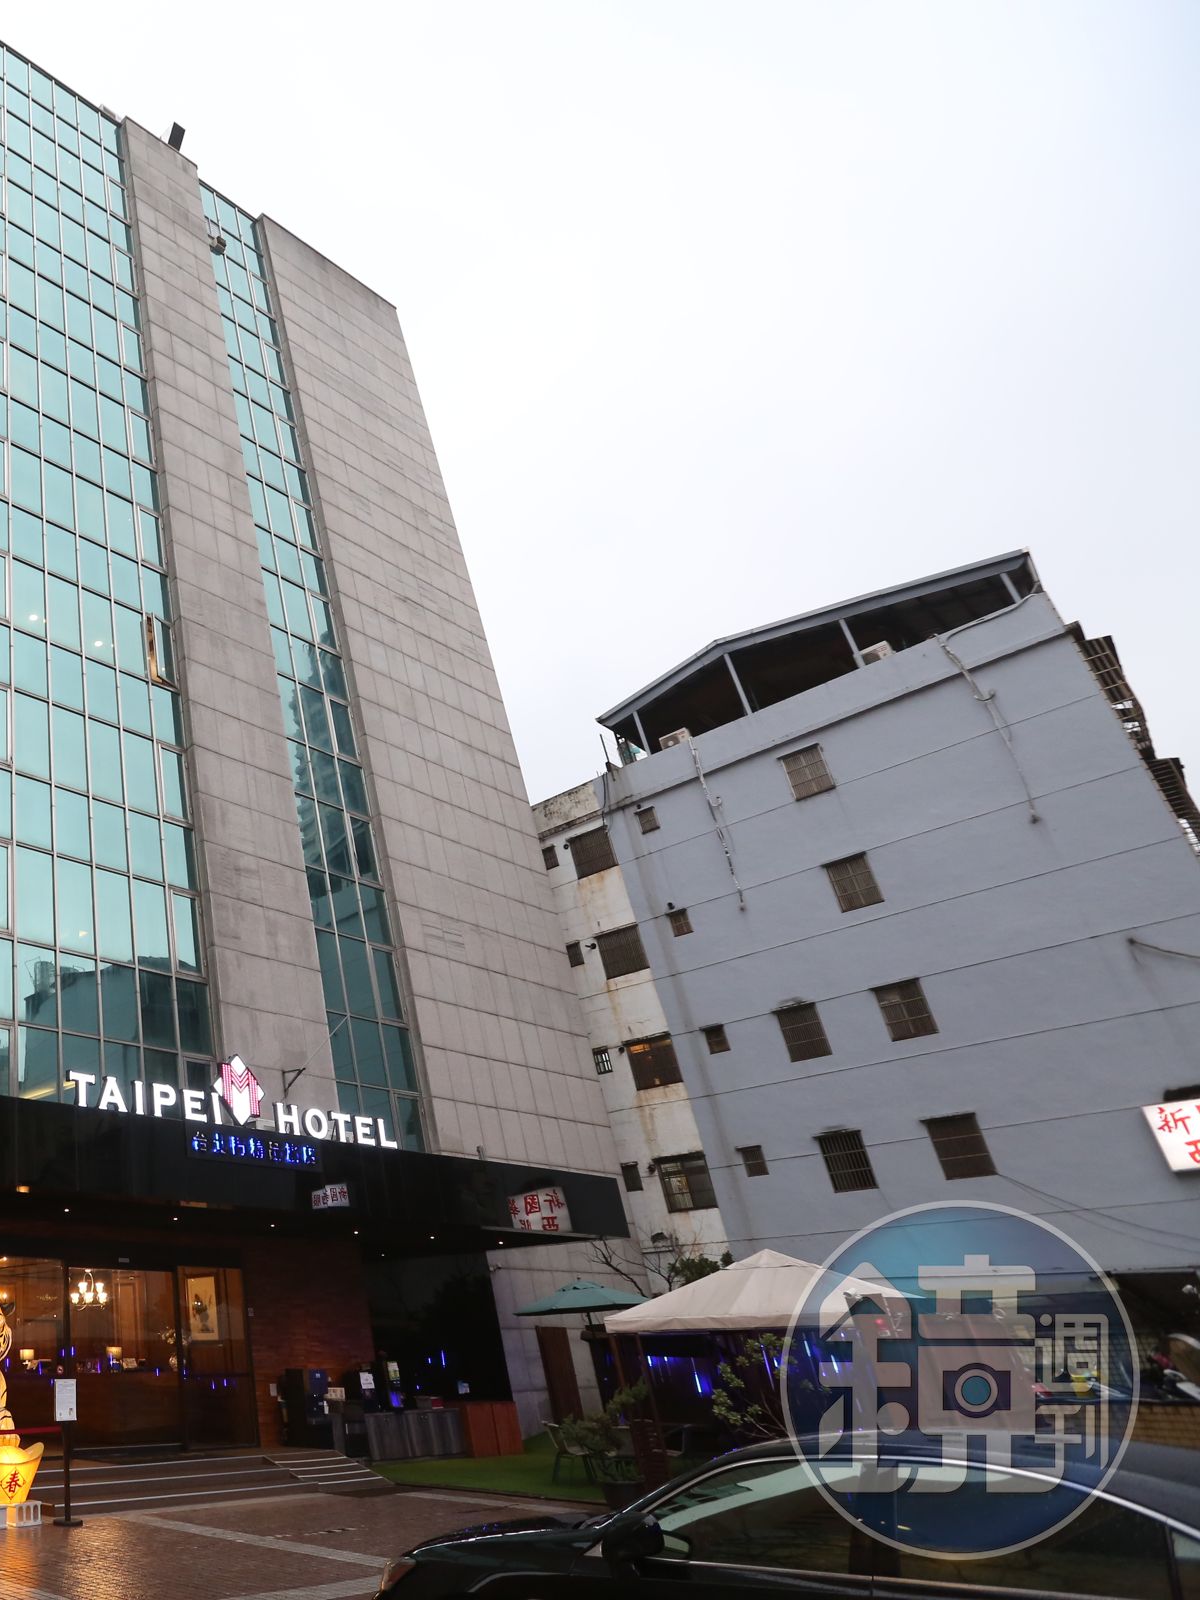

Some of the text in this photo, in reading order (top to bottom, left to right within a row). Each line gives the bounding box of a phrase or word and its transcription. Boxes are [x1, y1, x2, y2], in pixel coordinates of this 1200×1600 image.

[66, 1070, 222, 1125] TAIPEI
[273, 1102, 398, 1149] HOTEL
[1157, 1104, 1200, 1135] 新
[5, 1470, 23, 1493] 春
